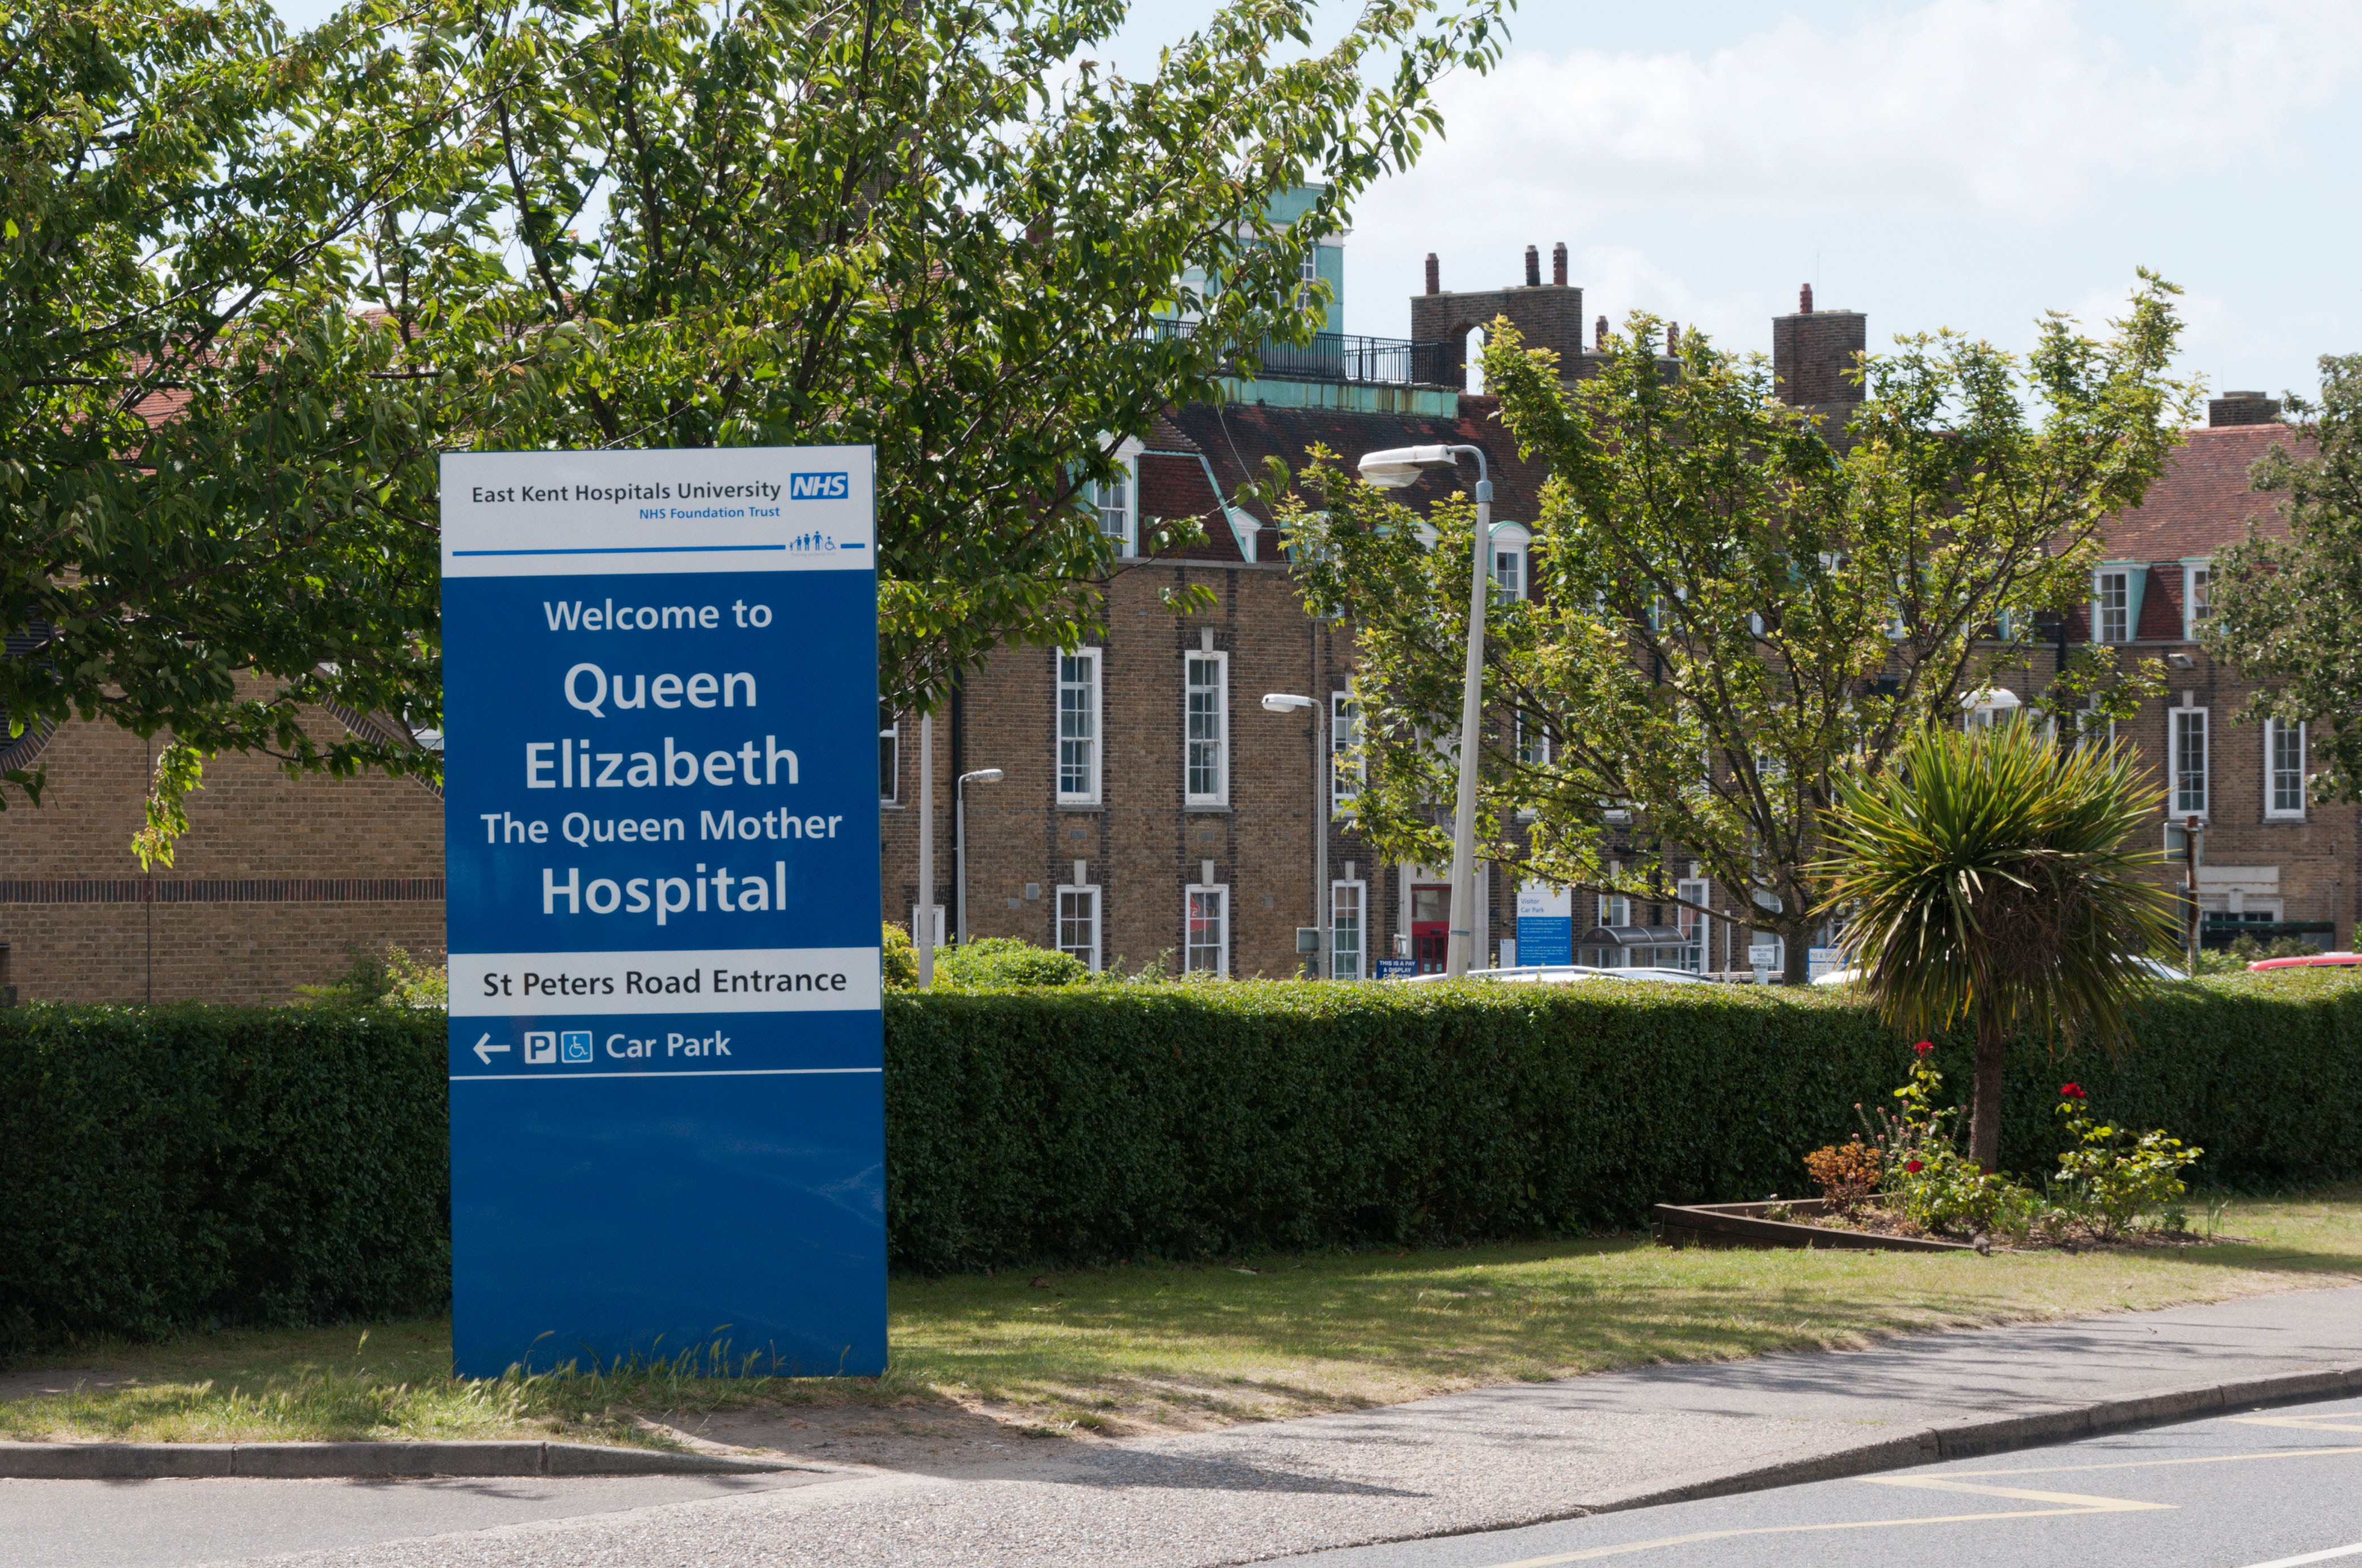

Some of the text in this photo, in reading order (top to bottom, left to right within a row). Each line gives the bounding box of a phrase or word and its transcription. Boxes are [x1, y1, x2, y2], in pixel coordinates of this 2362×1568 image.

[473, 480, 781, 505] East Kent Hospitals University
[793, 475, 846, 497] NHS
[640, 507, 780, 519] NHS Foundation Trust
[543, 598, 772, 631] Welcome to
[564, 663, 756, 717] Queen
[527, 735, 798, 789] Elizabeth
[480, 807, 842, 847] The Queen Mother
[543, 861, 786, 926] Hospital
[484, 968, 847, 996] St Peters Road Entrance
[530, 1030, 731, 1060] P Car Park
